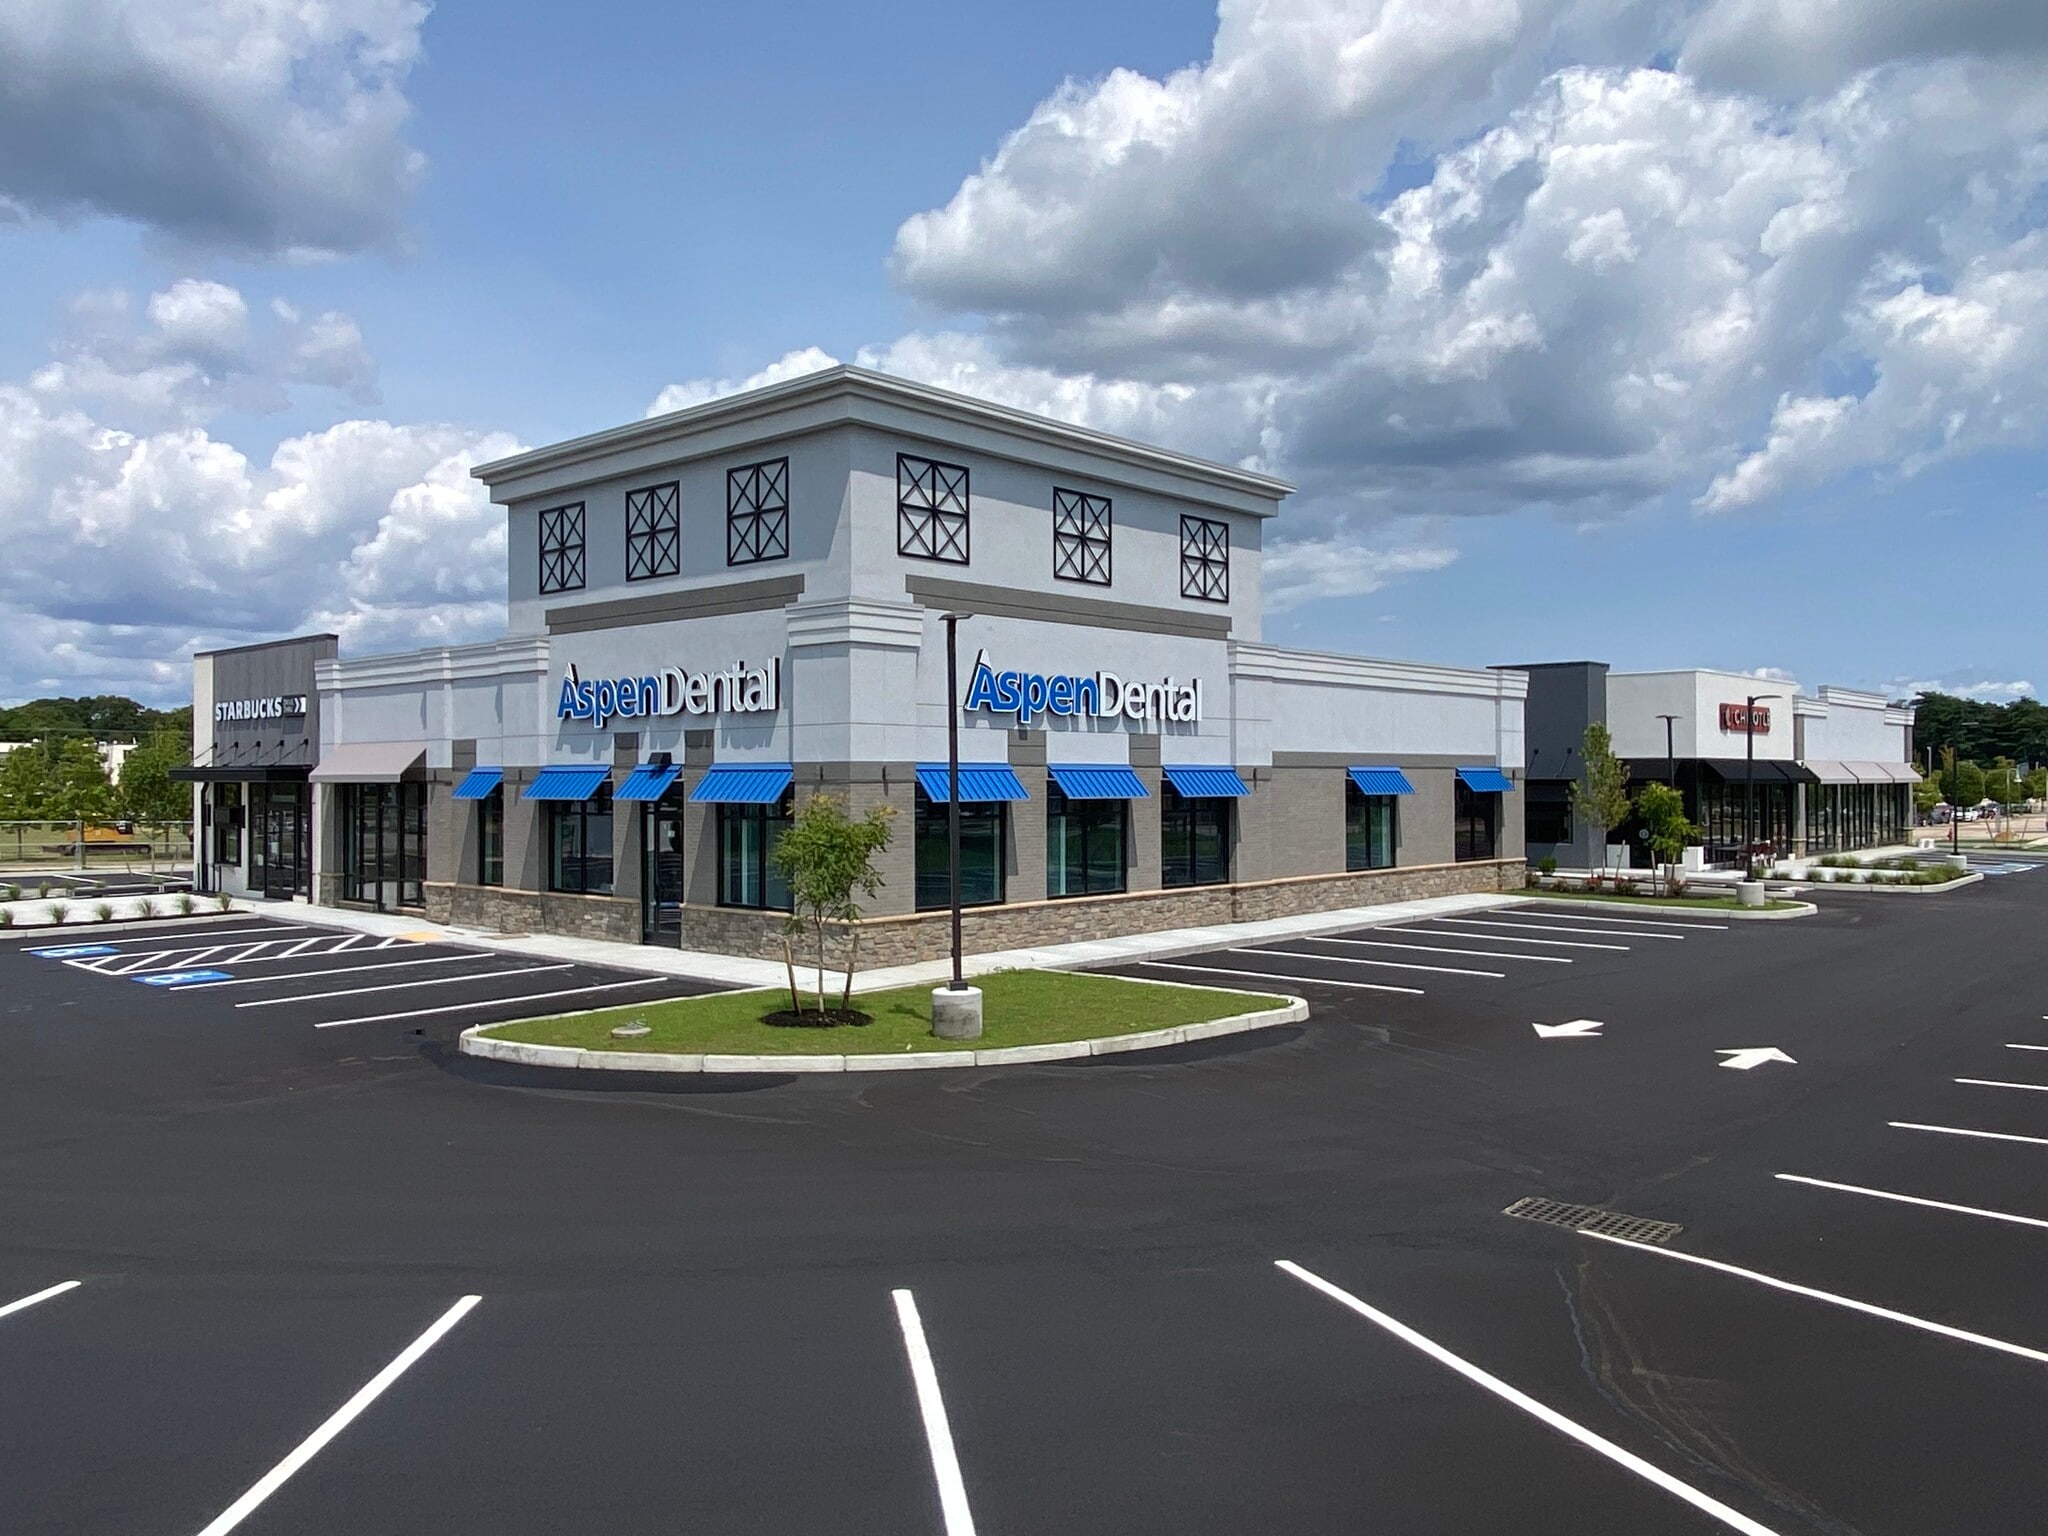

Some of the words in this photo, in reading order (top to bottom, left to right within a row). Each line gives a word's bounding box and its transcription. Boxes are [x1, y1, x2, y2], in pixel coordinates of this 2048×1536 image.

[215, 697, 283, 722] STARBUCKS
[557, 657, 779, 729] AspenDental
[966, 648, 1203, 724] AspenDental
